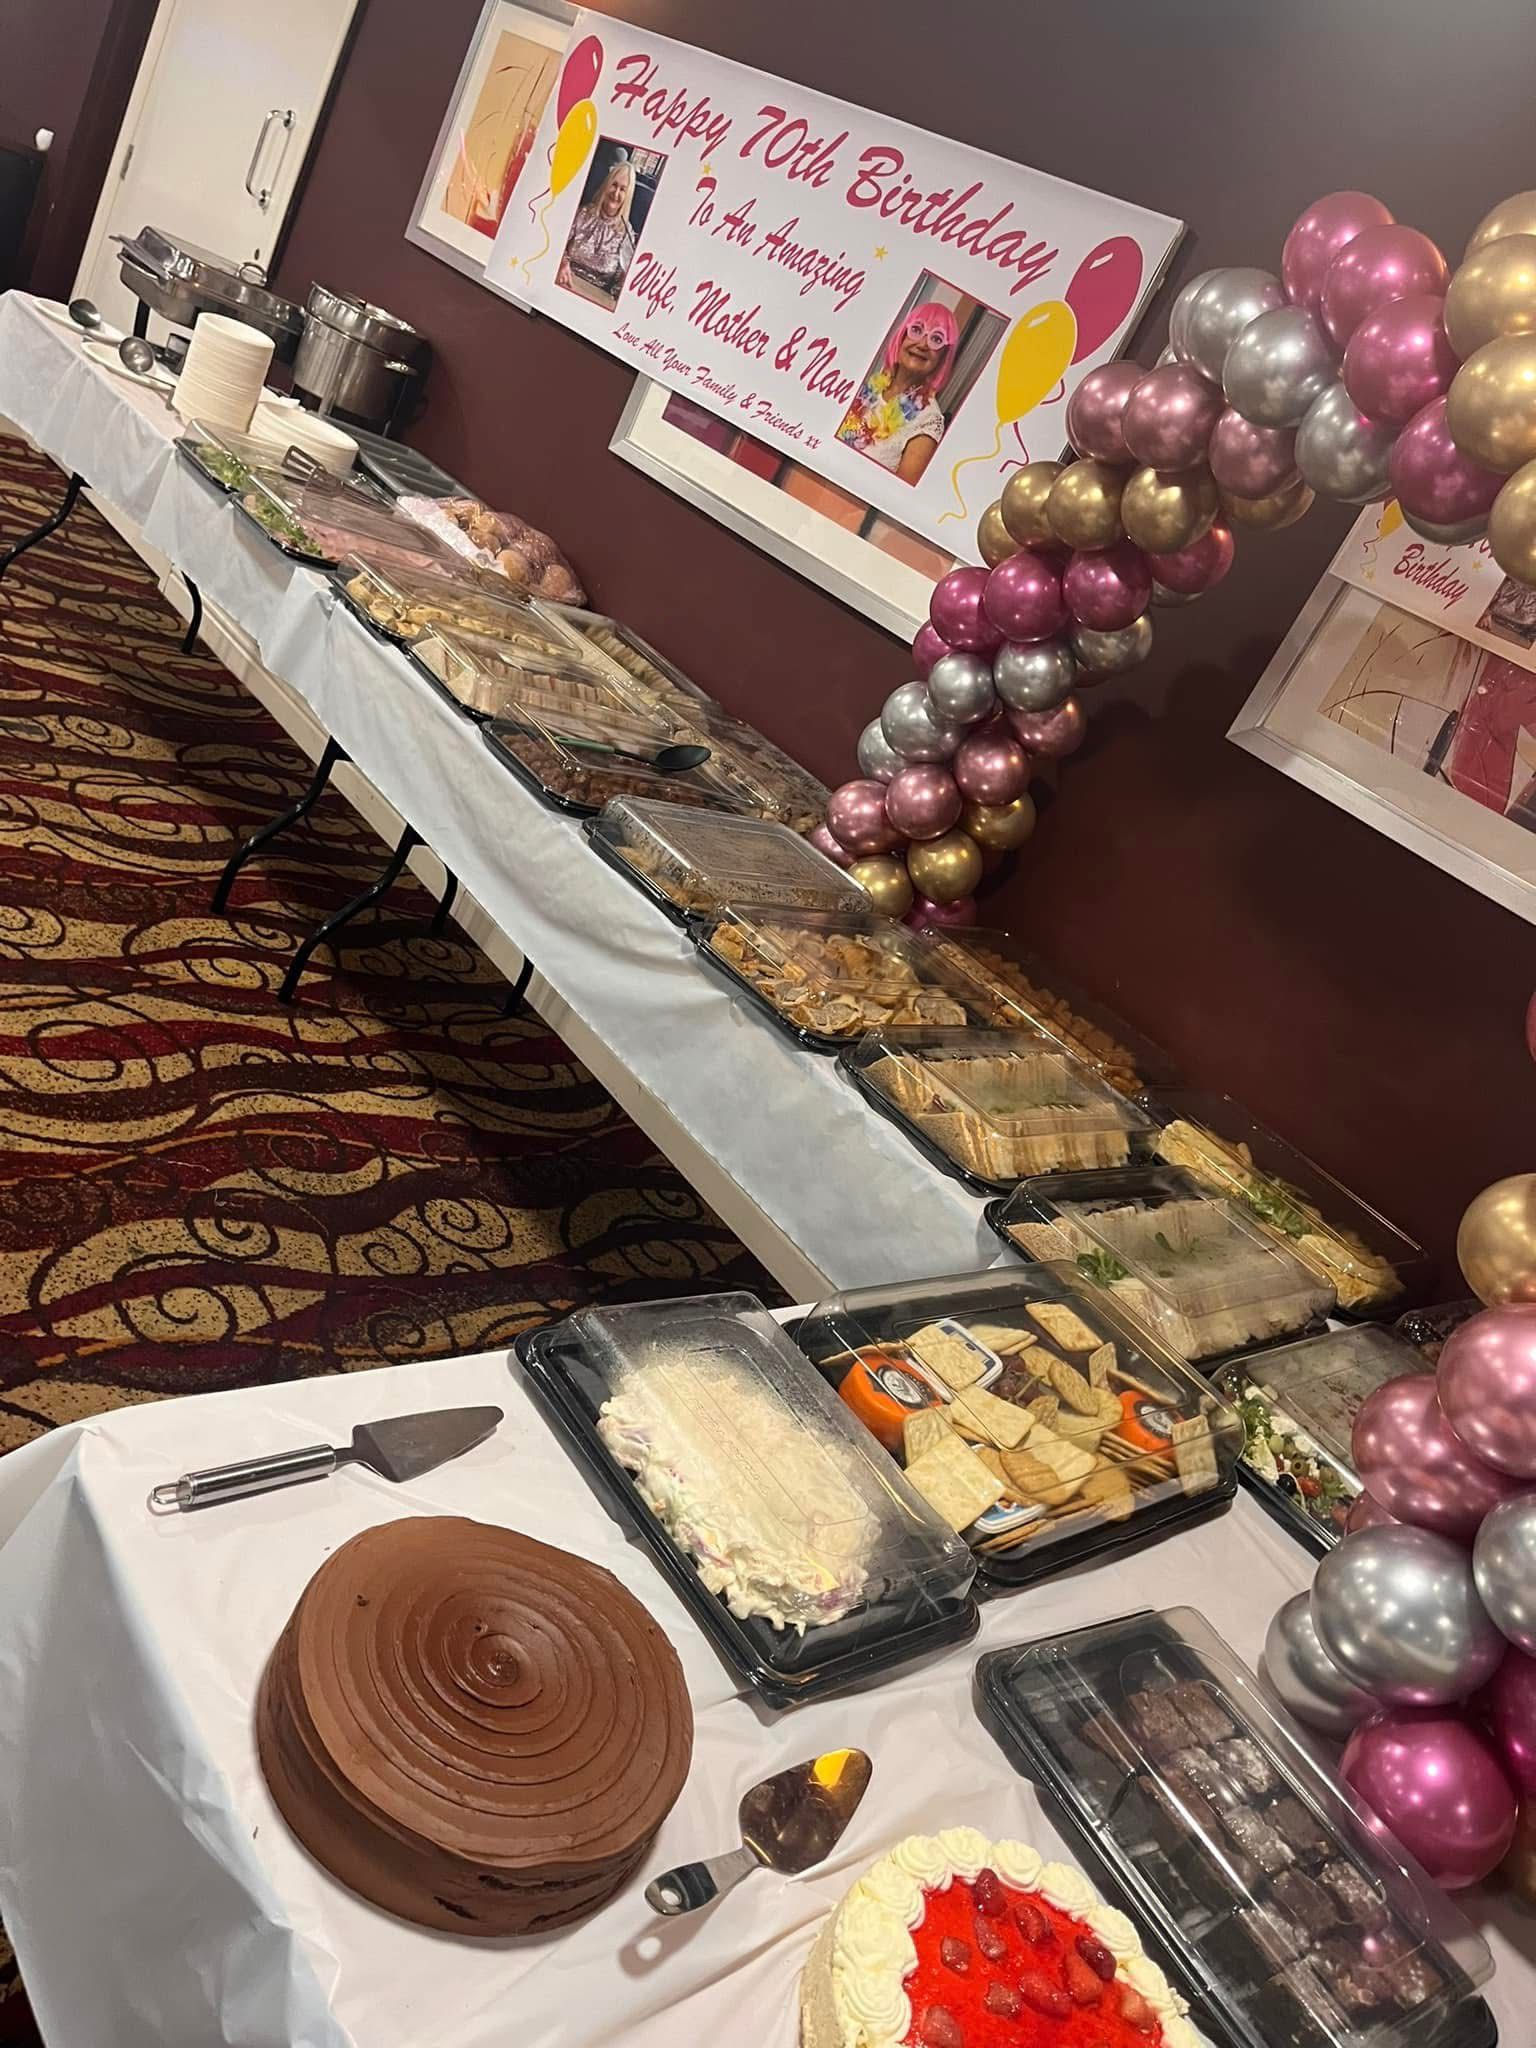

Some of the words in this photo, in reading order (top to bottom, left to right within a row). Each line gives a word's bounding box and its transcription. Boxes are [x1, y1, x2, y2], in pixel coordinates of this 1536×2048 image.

[610, 54, 732, 160] Happy
[739, 106, 849, 187] 70th
[846, 146, 1059, 296] Birthday
[689, 176, 717, 226] To
[711, 198, 757, 246] An
[752, 217, 865, 312] Amazing
[612, 322, 640, 346] Love
[639, 339, 664, 359] All
[662, 348, 691, 376] Your
[691, 366, 738, 405] Family
[740, 392, 757, 409] &
[750, 401, 803, 439] Friends
[803, 435, 821, 449] xx
[628, 252, 677, 319] Wife,
[688, 281, 770, 358] Mother
[774, 326, 807, 372] &
[800, 337, 855, 404] Nan
[1393, 543, 1469, 610] Birthday
